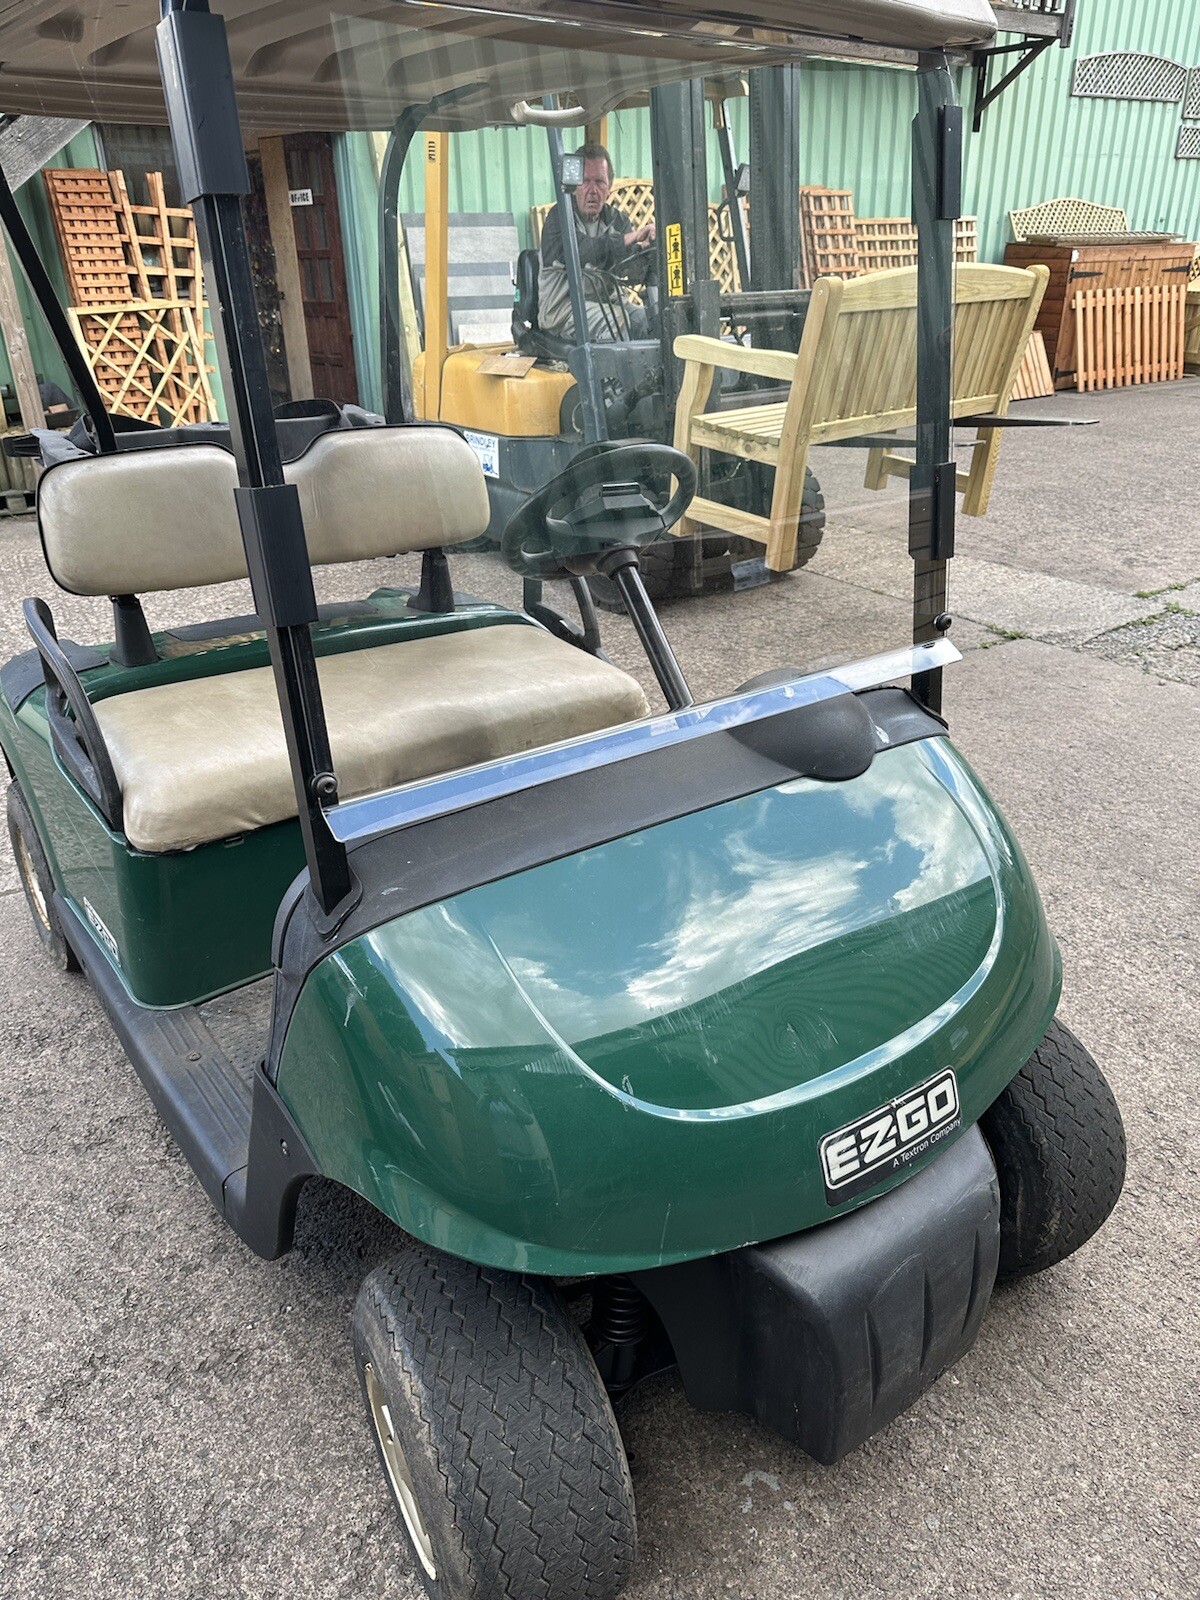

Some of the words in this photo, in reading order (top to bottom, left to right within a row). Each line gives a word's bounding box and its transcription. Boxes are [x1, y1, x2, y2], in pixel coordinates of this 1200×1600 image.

[290, 192, 309, 203] OFFICE
[893, 1158, 900, 1168] A
[901, 1140, 929, 1162] Textron
[930, 1118, 961, 1144] Company
